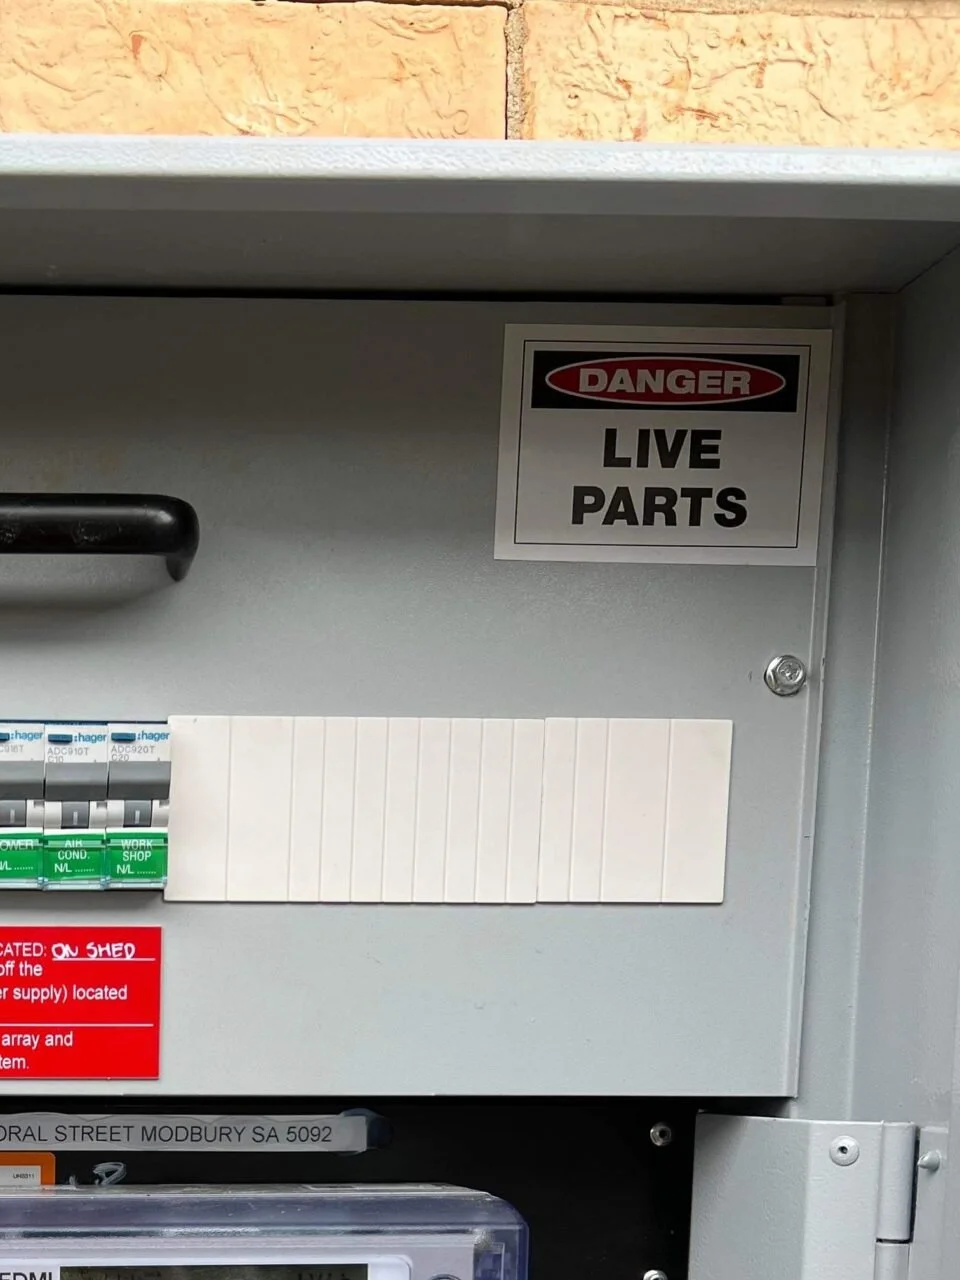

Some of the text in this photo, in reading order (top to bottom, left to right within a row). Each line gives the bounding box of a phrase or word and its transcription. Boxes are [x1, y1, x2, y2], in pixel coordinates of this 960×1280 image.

[578, 368, 751, 395] DANGER
[603, 428, 722, 469] LIVE
[571, 485, 748, 528] PARTS
[121, 839, 153, 850] WORK
[57, 850, 90, 861] COND.
[122, 851, 152, 862] SHOP
[51, 942, 137, 960] ON SHED
[19, 961, 43, 976] the
[13, 984, 67, 1004] supply)
[73, 984, 128, 1000] located
[1, 1034, 39, 1050] array
[45, 1031, 73, 1047] and
[54, 1125, 134, 1142] STREET
[141, 1126, 247, 1143] MODBURY
[251, 1127, 280, 1143] SA
[286, 1126, 333, 1143] 5092
